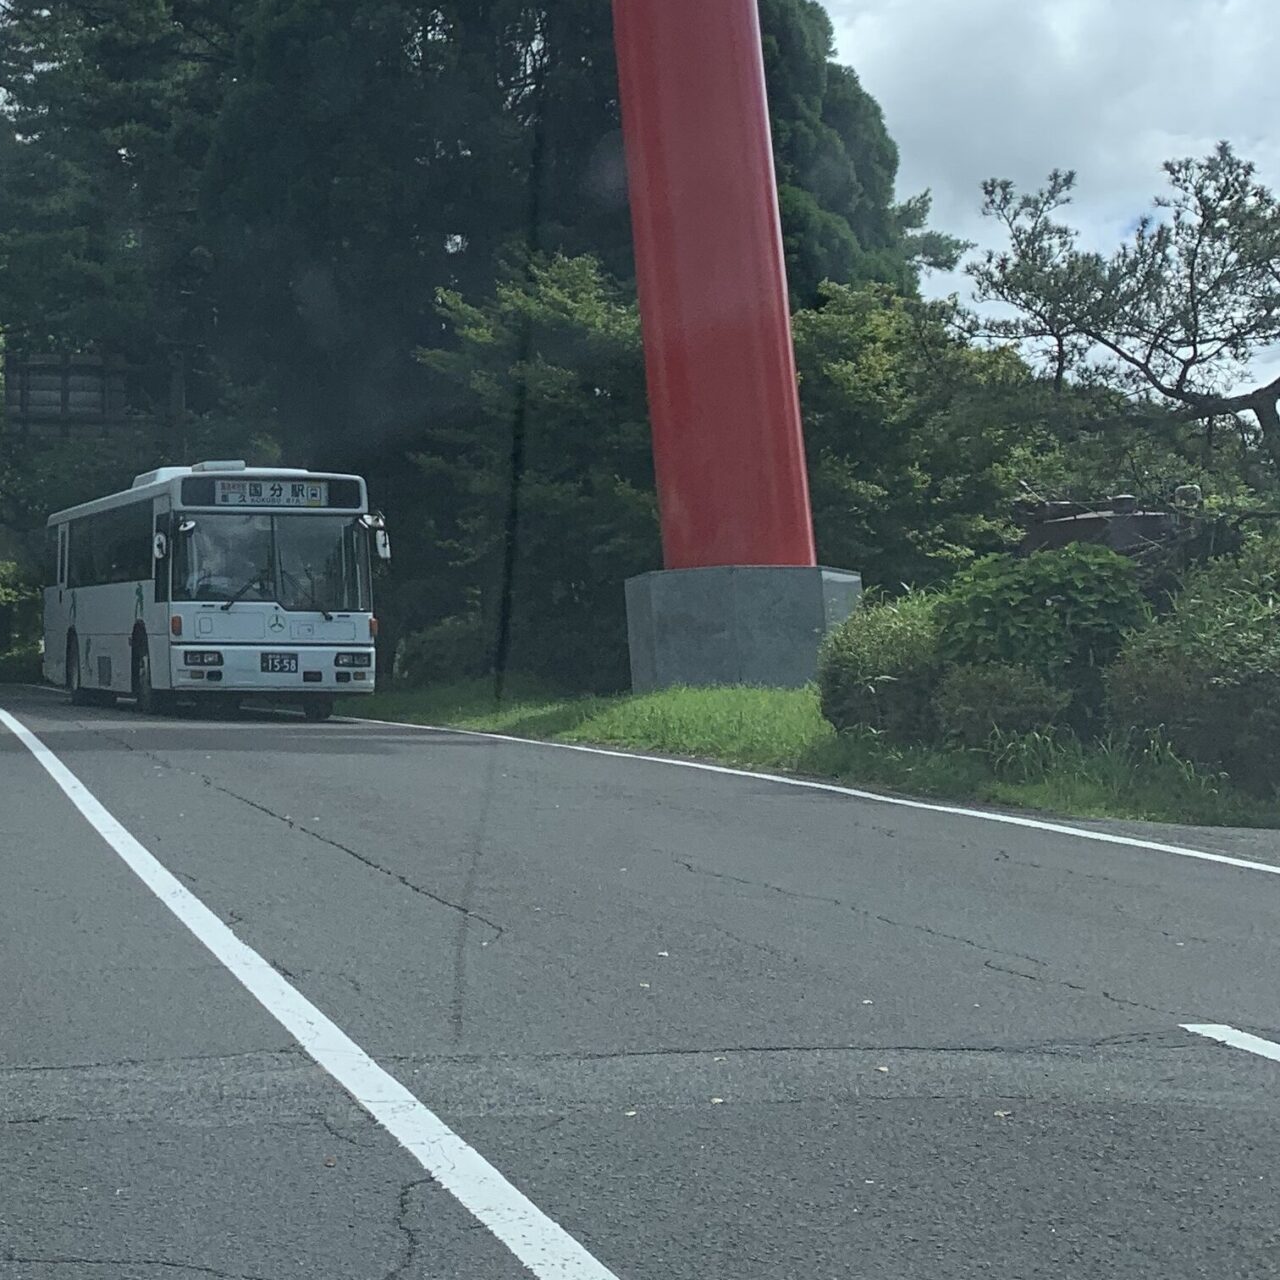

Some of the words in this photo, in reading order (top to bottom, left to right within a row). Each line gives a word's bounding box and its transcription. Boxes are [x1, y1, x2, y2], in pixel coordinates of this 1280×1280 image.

[248, 483, 305, 498] 国分駅
[268, 659, 296, 671] 15-58
